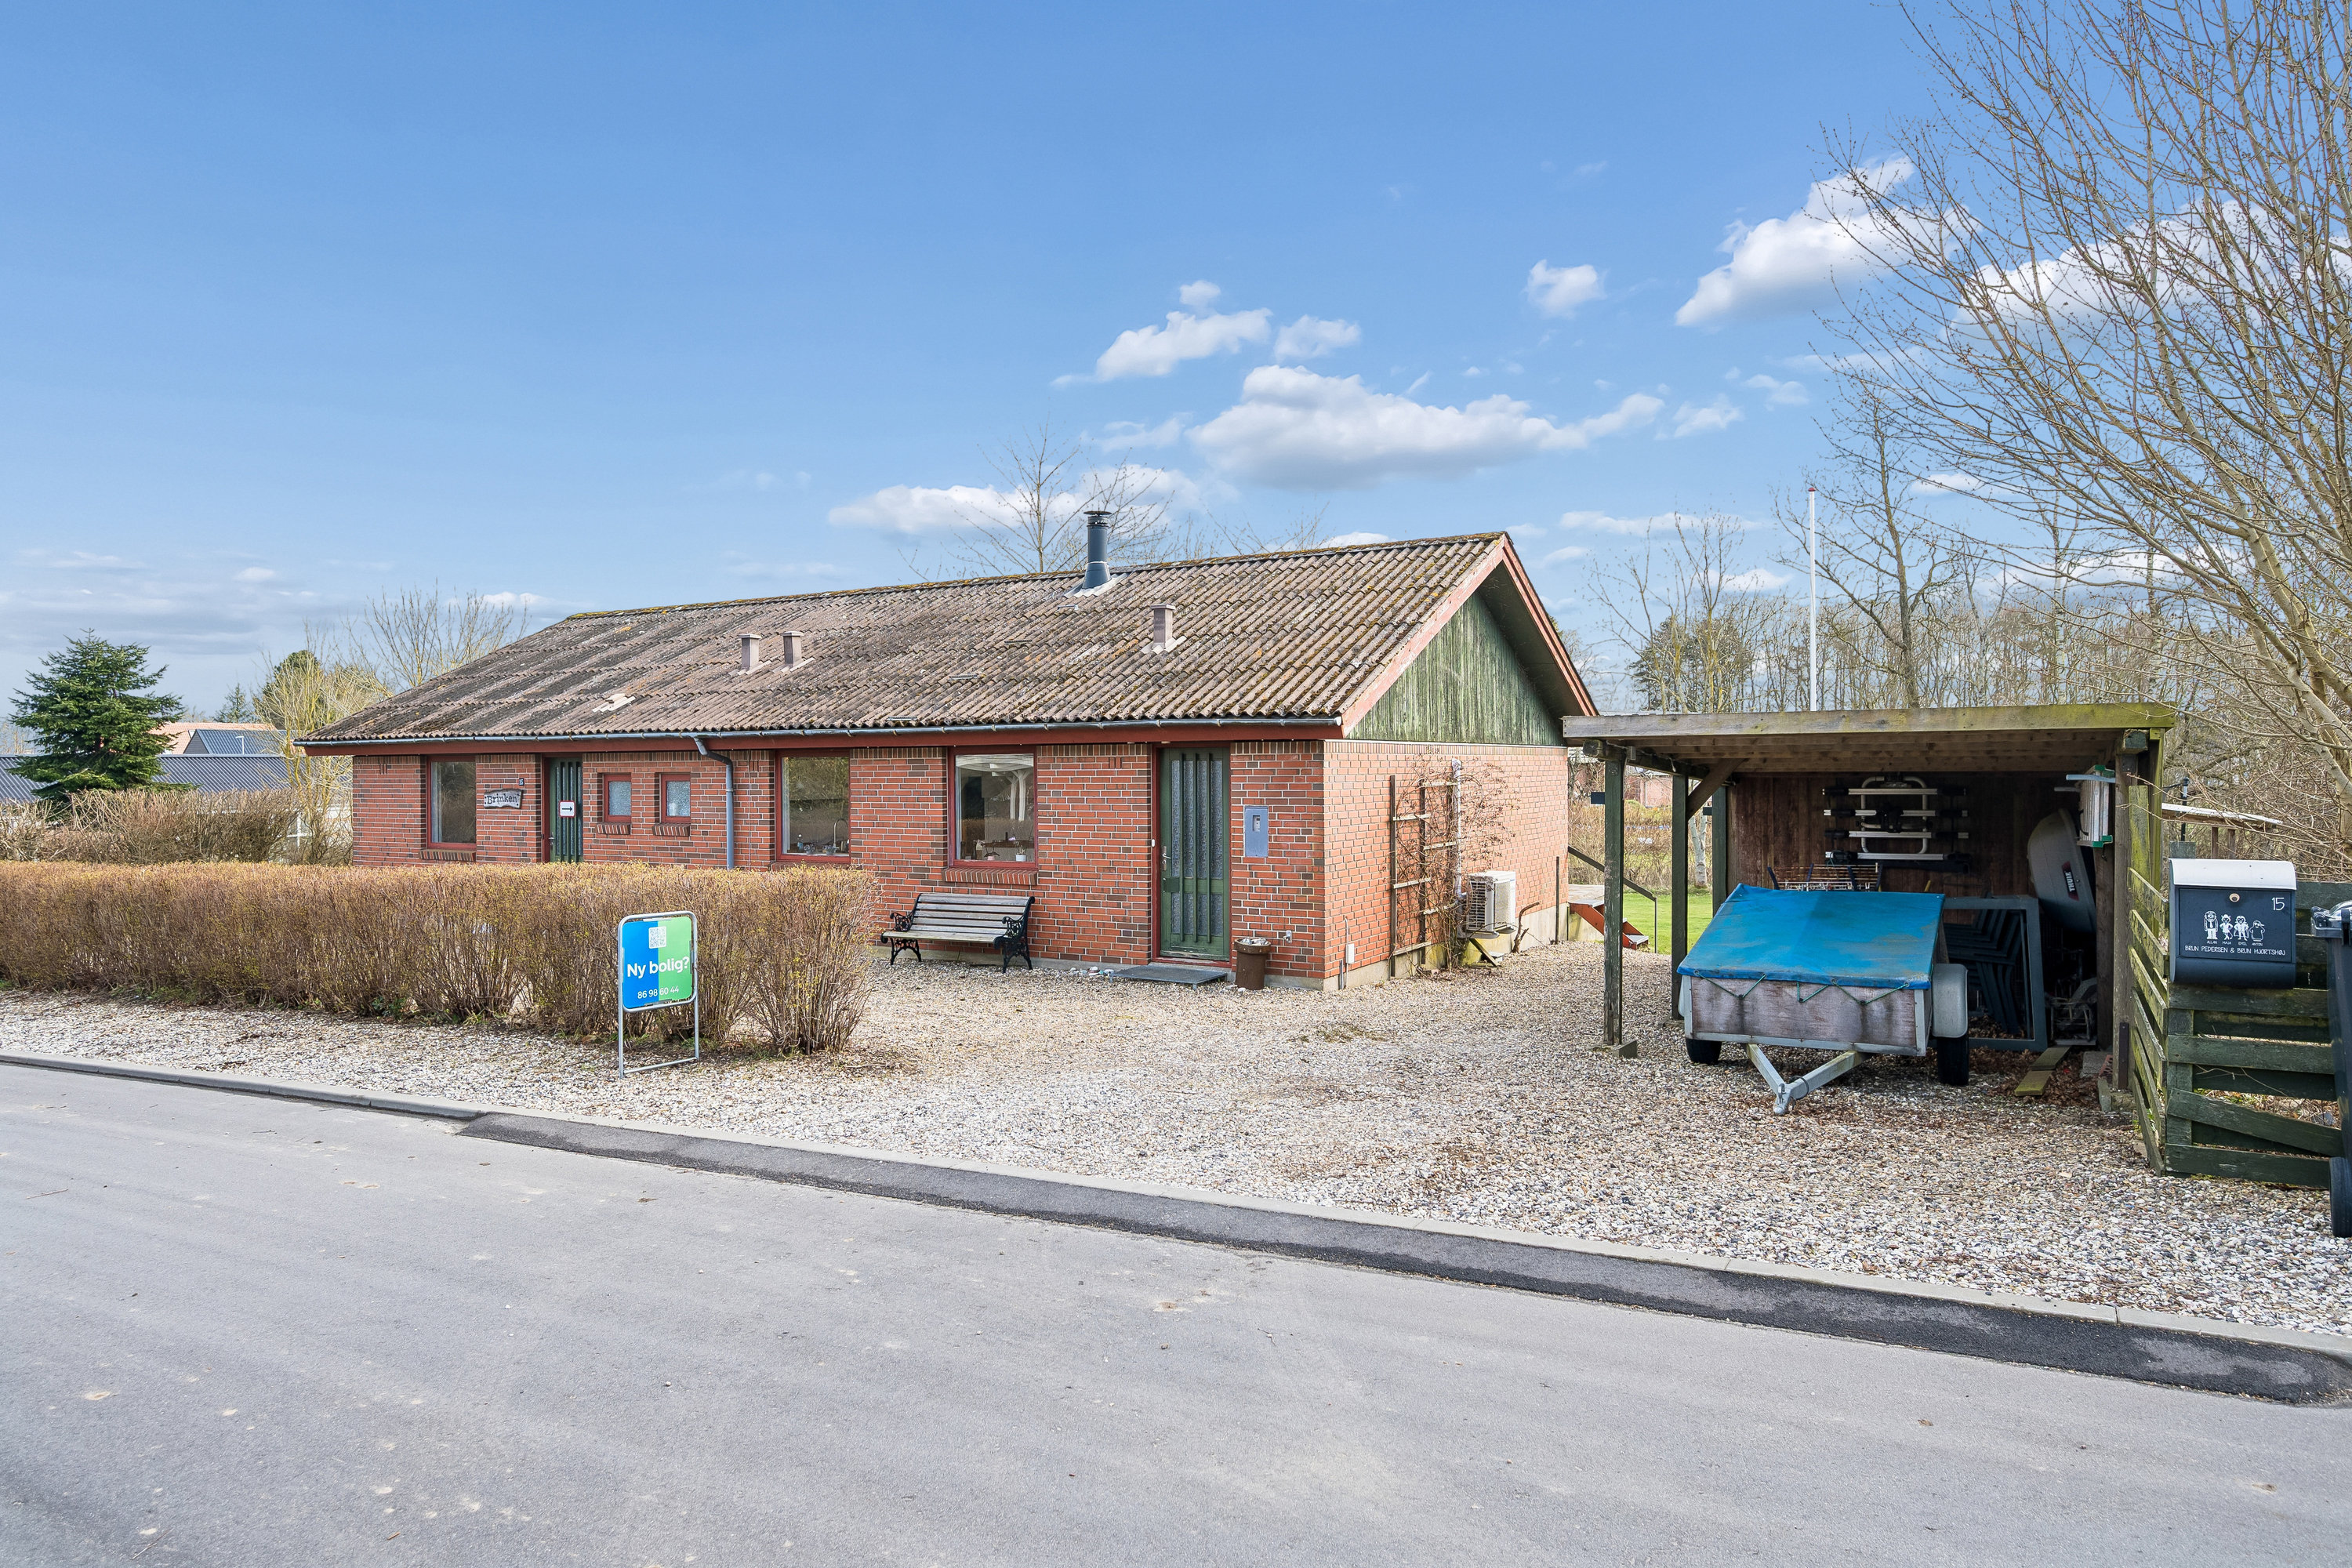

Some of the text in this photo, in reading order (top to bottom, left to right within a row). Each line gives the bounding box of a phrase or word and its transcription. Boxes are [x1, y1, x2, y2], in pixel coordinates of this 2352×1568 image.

[487, 793, 517, 804] Brinken
[2065, 871, 2075, 892] THULE
[2271, 897, 2285, 911] 15
[627, 956, 689, 978] Ny bolig?
[637, 990, 647, 999] 86
[649, 989, 658, 997] 98
